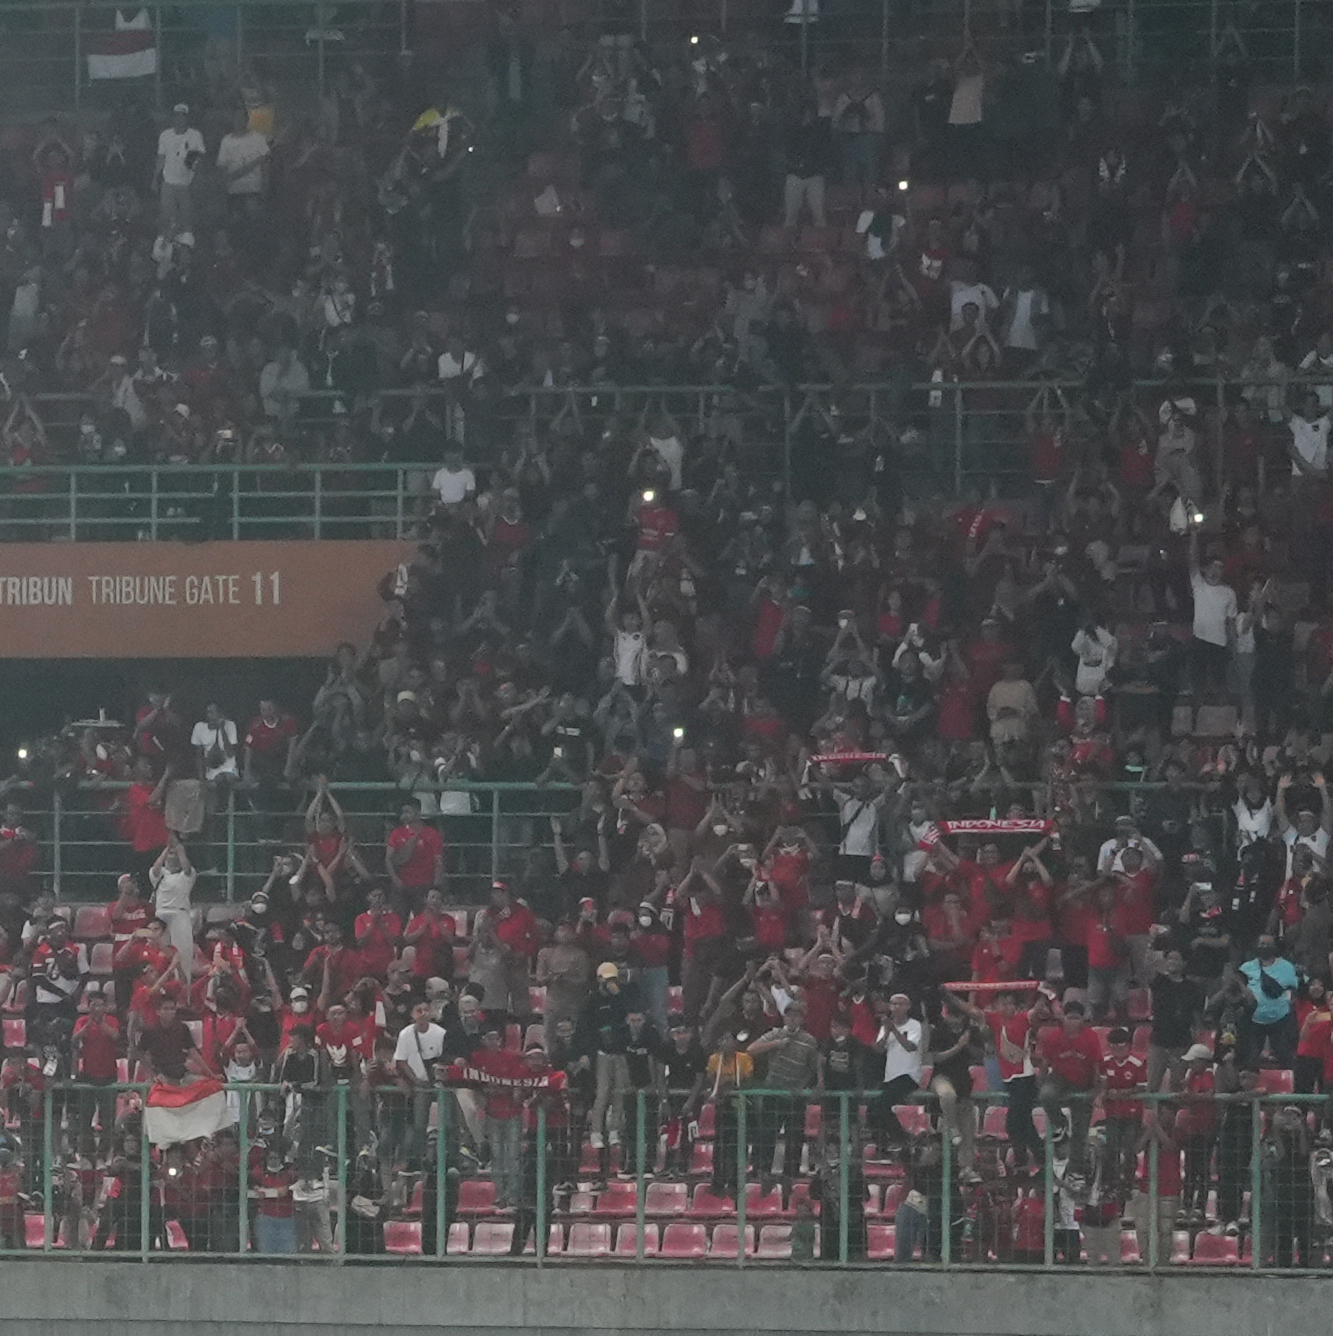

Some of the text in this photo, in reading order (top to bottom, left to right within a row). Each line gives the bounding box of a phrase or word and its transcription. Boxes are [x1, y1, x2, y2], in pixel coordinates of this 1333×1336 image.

[88, 575, 177, 605] TRIBUNE
[185, 575, 241, 605] GATE
[252, 571, 282, 605] 11
[946, 819, 1045, 830] INDONESIA
